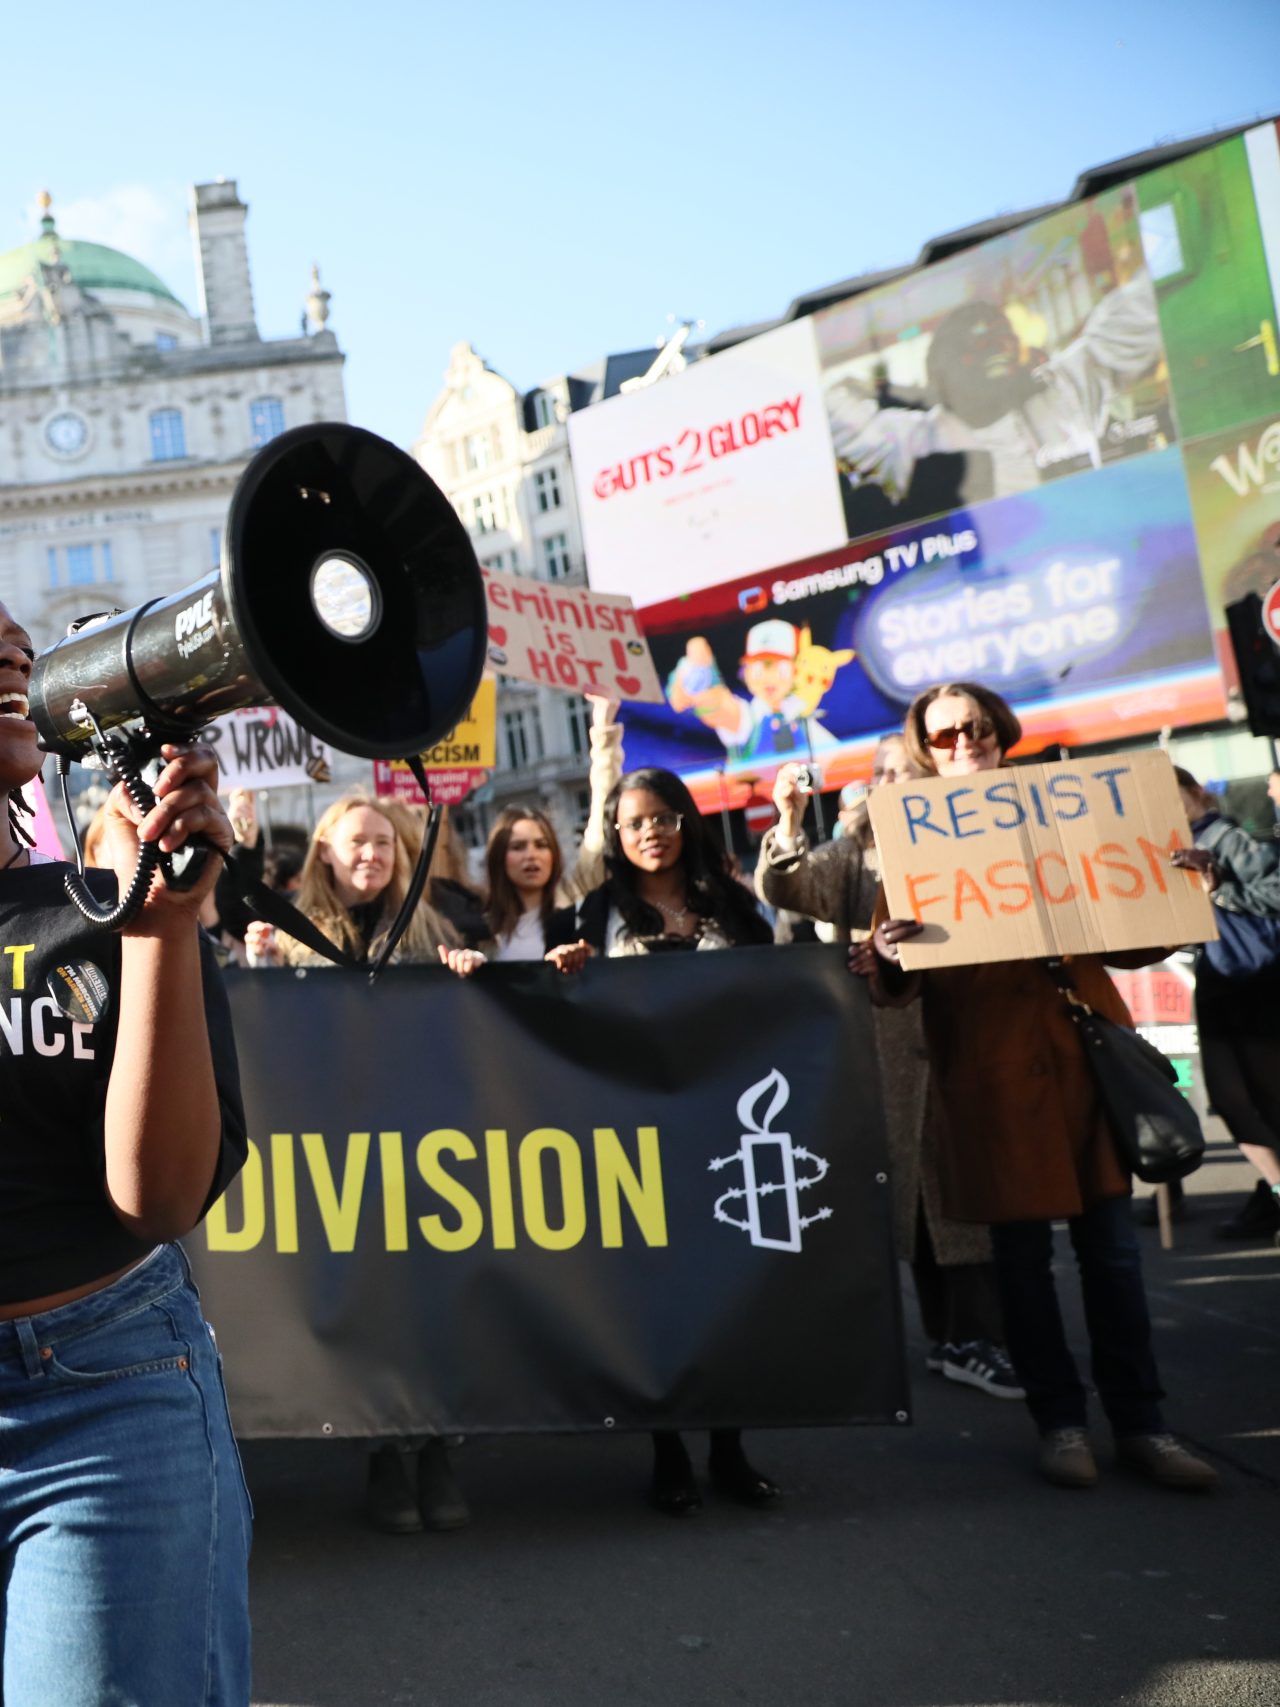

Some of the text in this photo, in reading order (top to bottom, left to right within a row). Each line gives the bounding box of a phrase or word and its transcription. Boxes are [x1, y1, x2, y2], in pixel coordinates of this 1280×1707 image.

[480, 567, 646, 639] eminism
[772, 530, 977, 605] Samsung TV Plus
[878, 558, 1121, 649] Stories for
[175, 589, 215, 641] PYLE
[544, 625, 576, 655] is
[892, 605, 1119, 686] everyone
[228, 719, 324, 773] WRONG
[395, 744, 480, 764] SCISM
[902, 767, 1131, 845] RESIST
[905, 829, 1200, 925] FASCISM
[72, 976, 99, 1017] MARCHING
[204, 1126, 668, 1253] DIVISION
